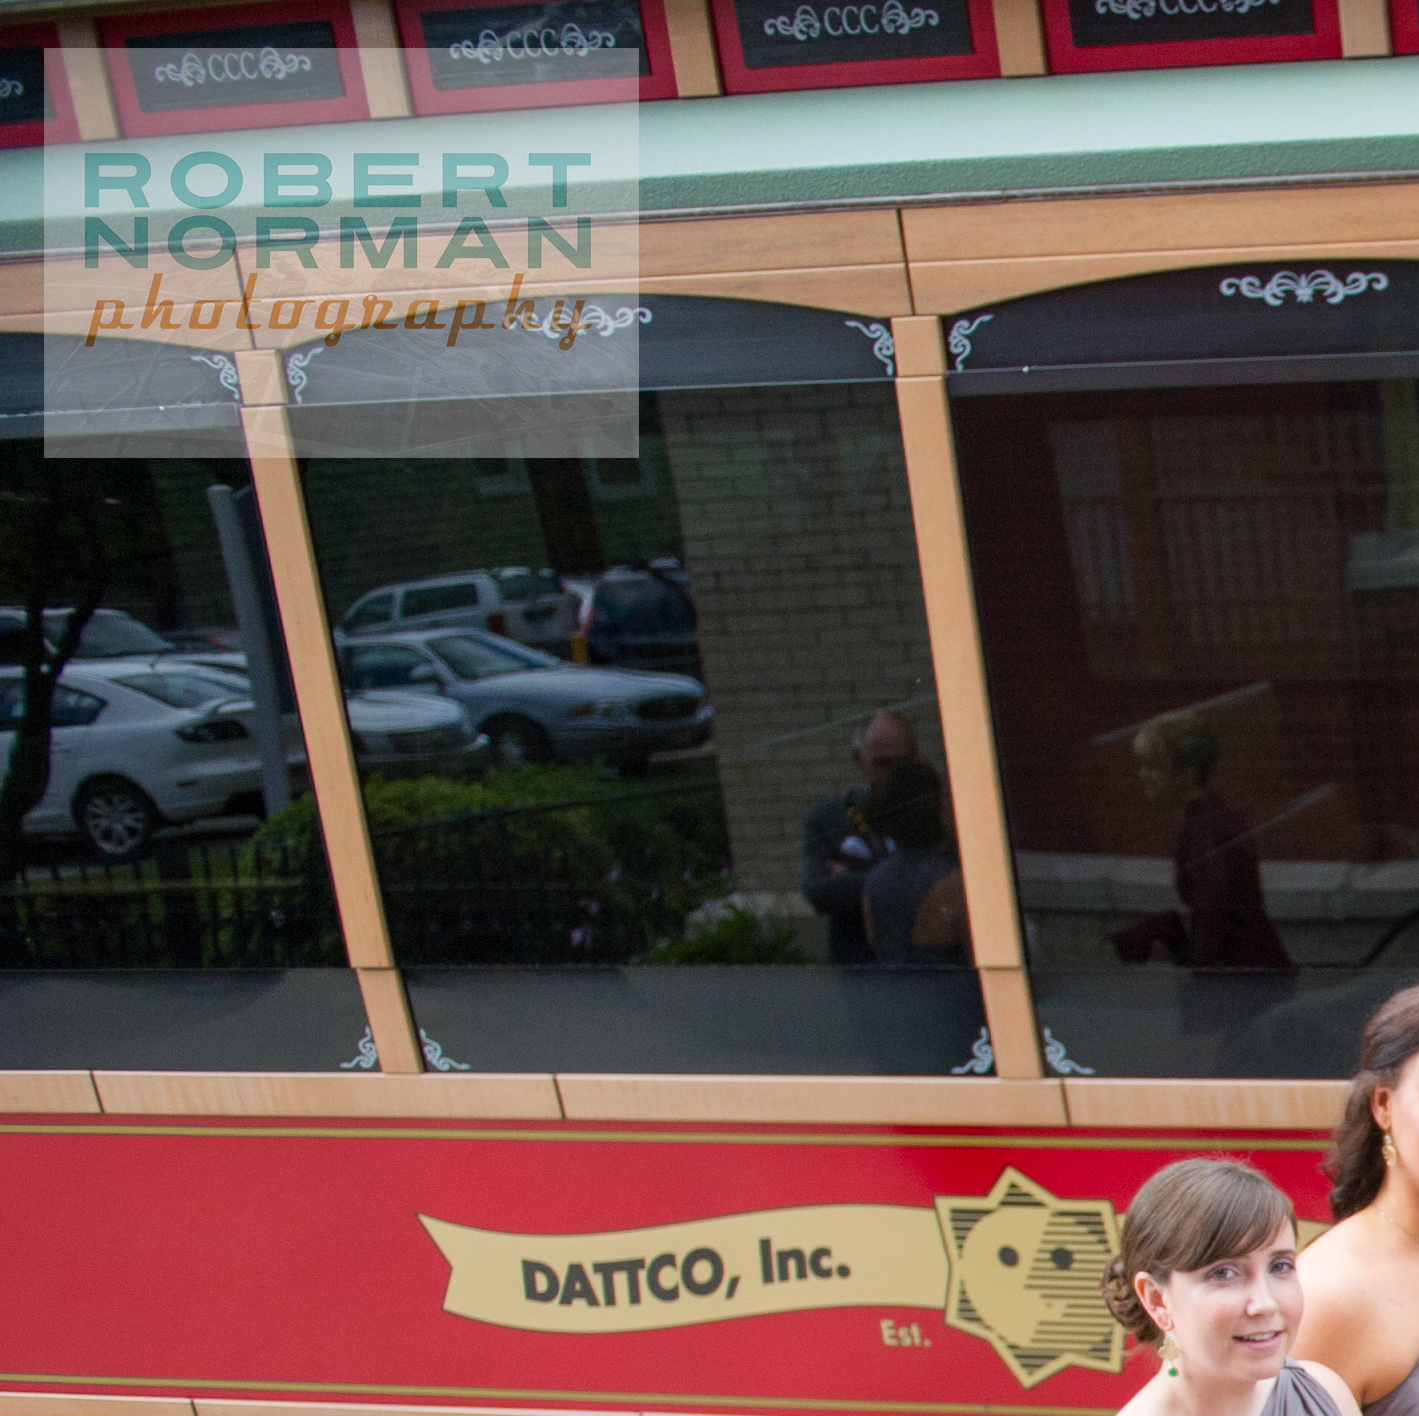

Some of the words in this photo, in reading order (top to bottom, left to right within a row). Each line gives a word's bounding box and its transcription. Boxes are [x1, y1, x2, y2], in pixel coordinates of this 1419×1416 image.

[520, 1246, 742, 1308] DATTCO,
[758, 1236, 852, 1286] Inc.
[878, 1318, 932, 1349] Est.
